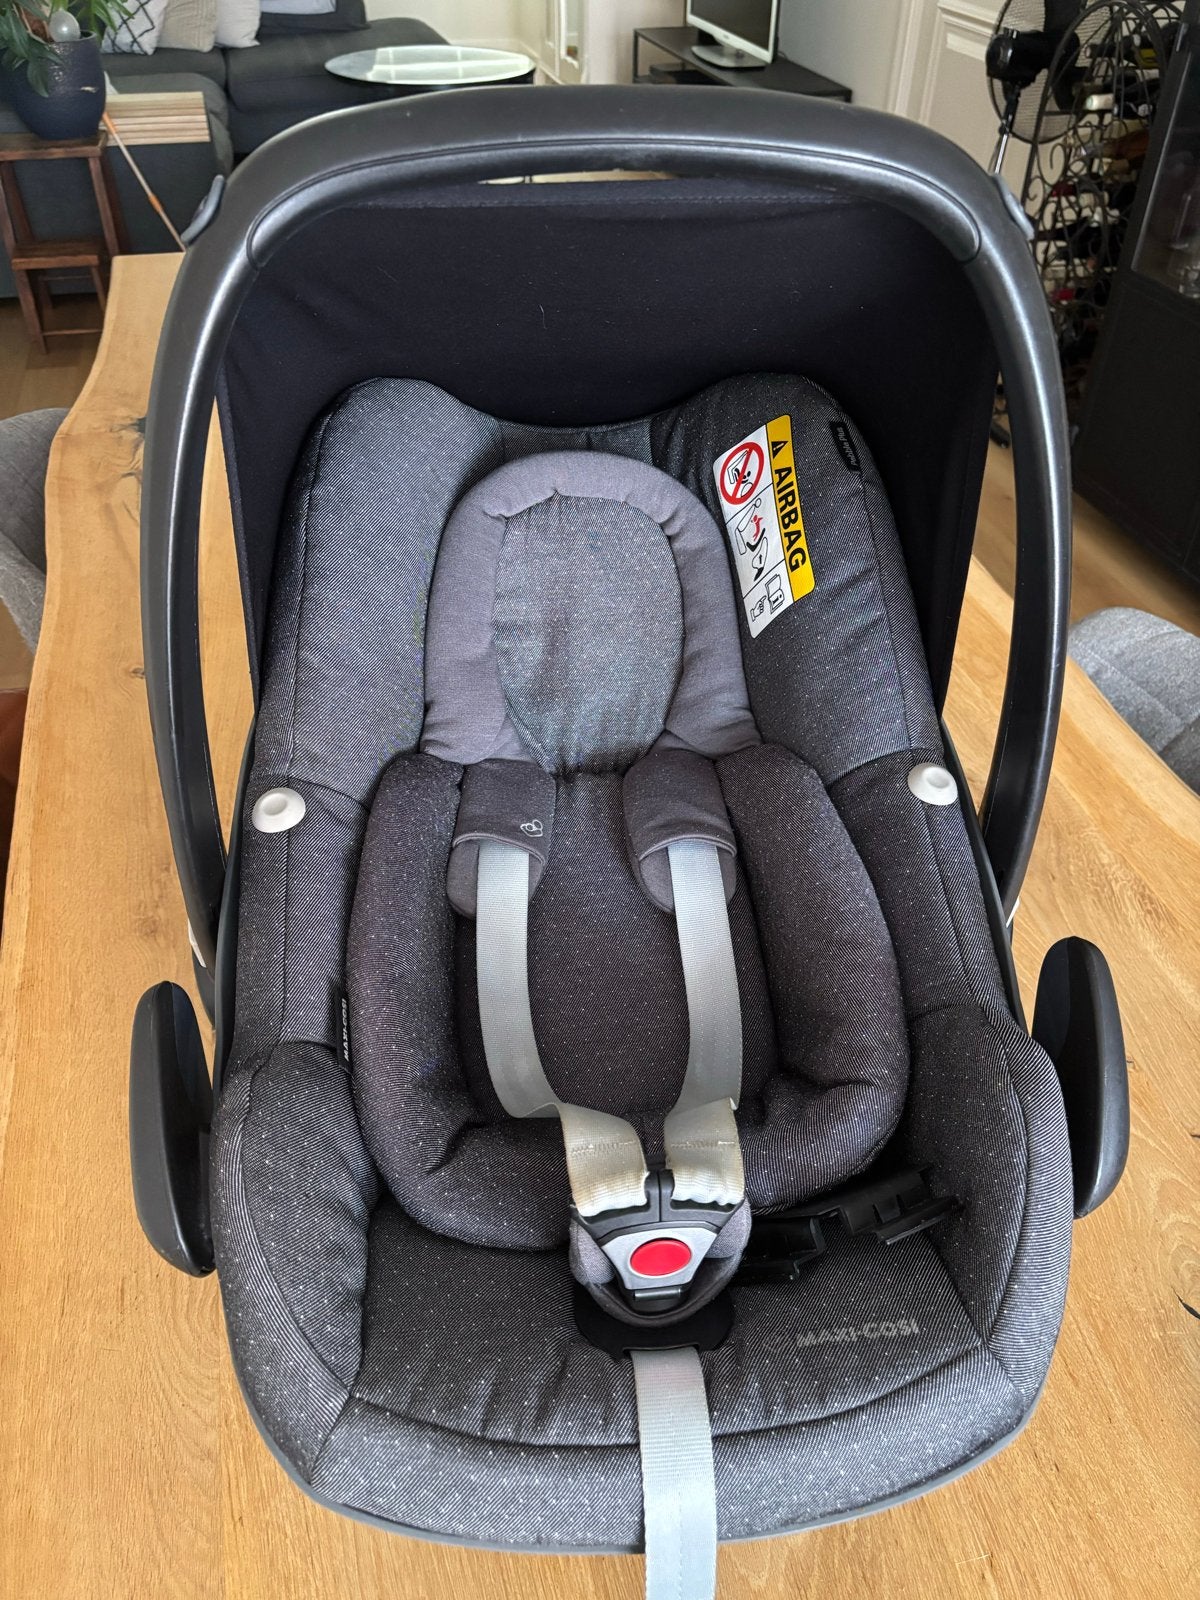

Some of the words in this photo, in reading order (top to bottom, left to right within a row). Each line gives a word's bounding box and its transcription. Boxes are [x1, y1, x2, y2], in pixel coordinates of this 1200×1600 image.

[774, 466, 807, 573] AIRBAG
[341, 998, 349, 1061] MAXI-COSI
[796, 1318, 919, 1348] MAXI-COSI
